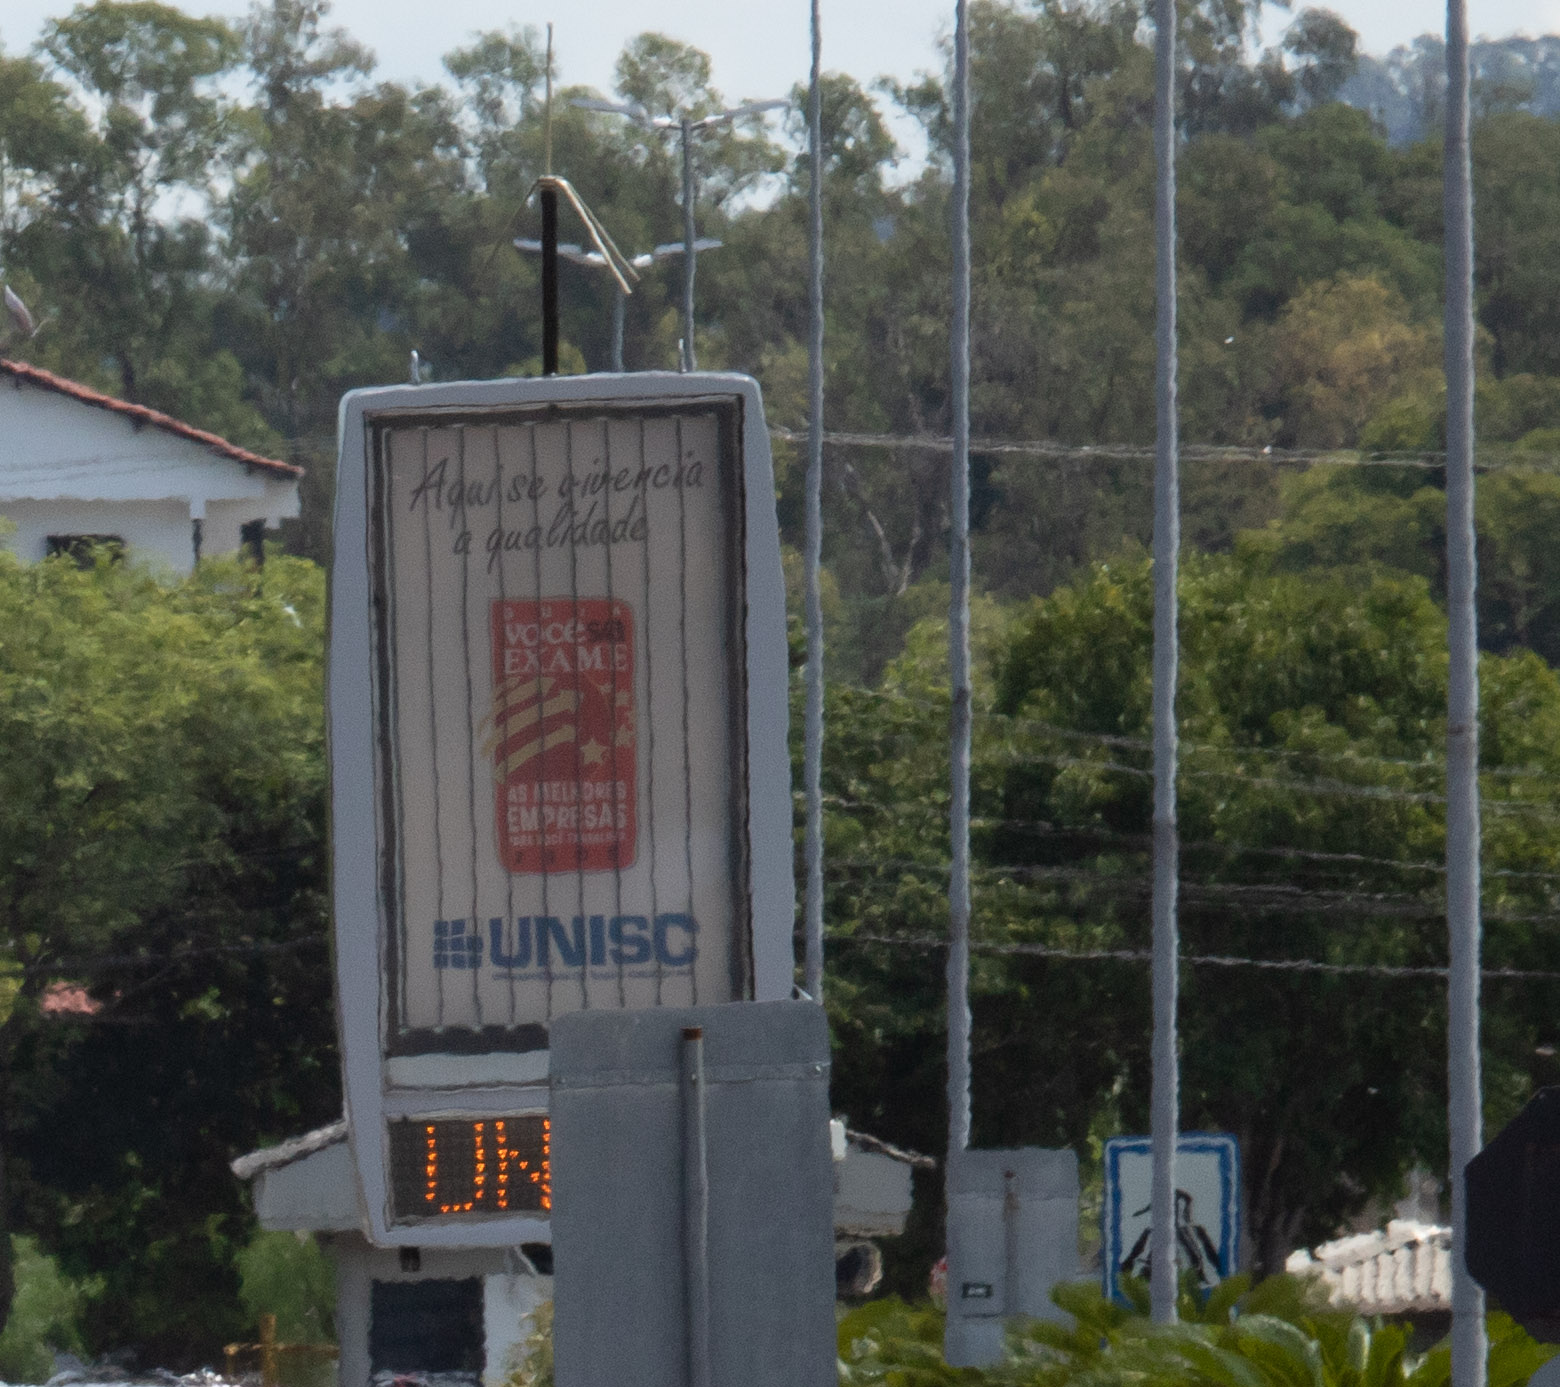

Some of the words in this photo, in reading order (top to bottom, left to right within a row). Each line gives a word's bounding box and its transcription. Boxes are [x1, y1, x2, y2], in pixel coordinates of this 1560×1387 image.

[508, 473, 546, 502] se
[453, 530, 472, 555] a
[504, 644, 627, 674] EXAME
[507, 803, 627, 832] EMPRESAS
[489, 912, 700, 968] UNISC
